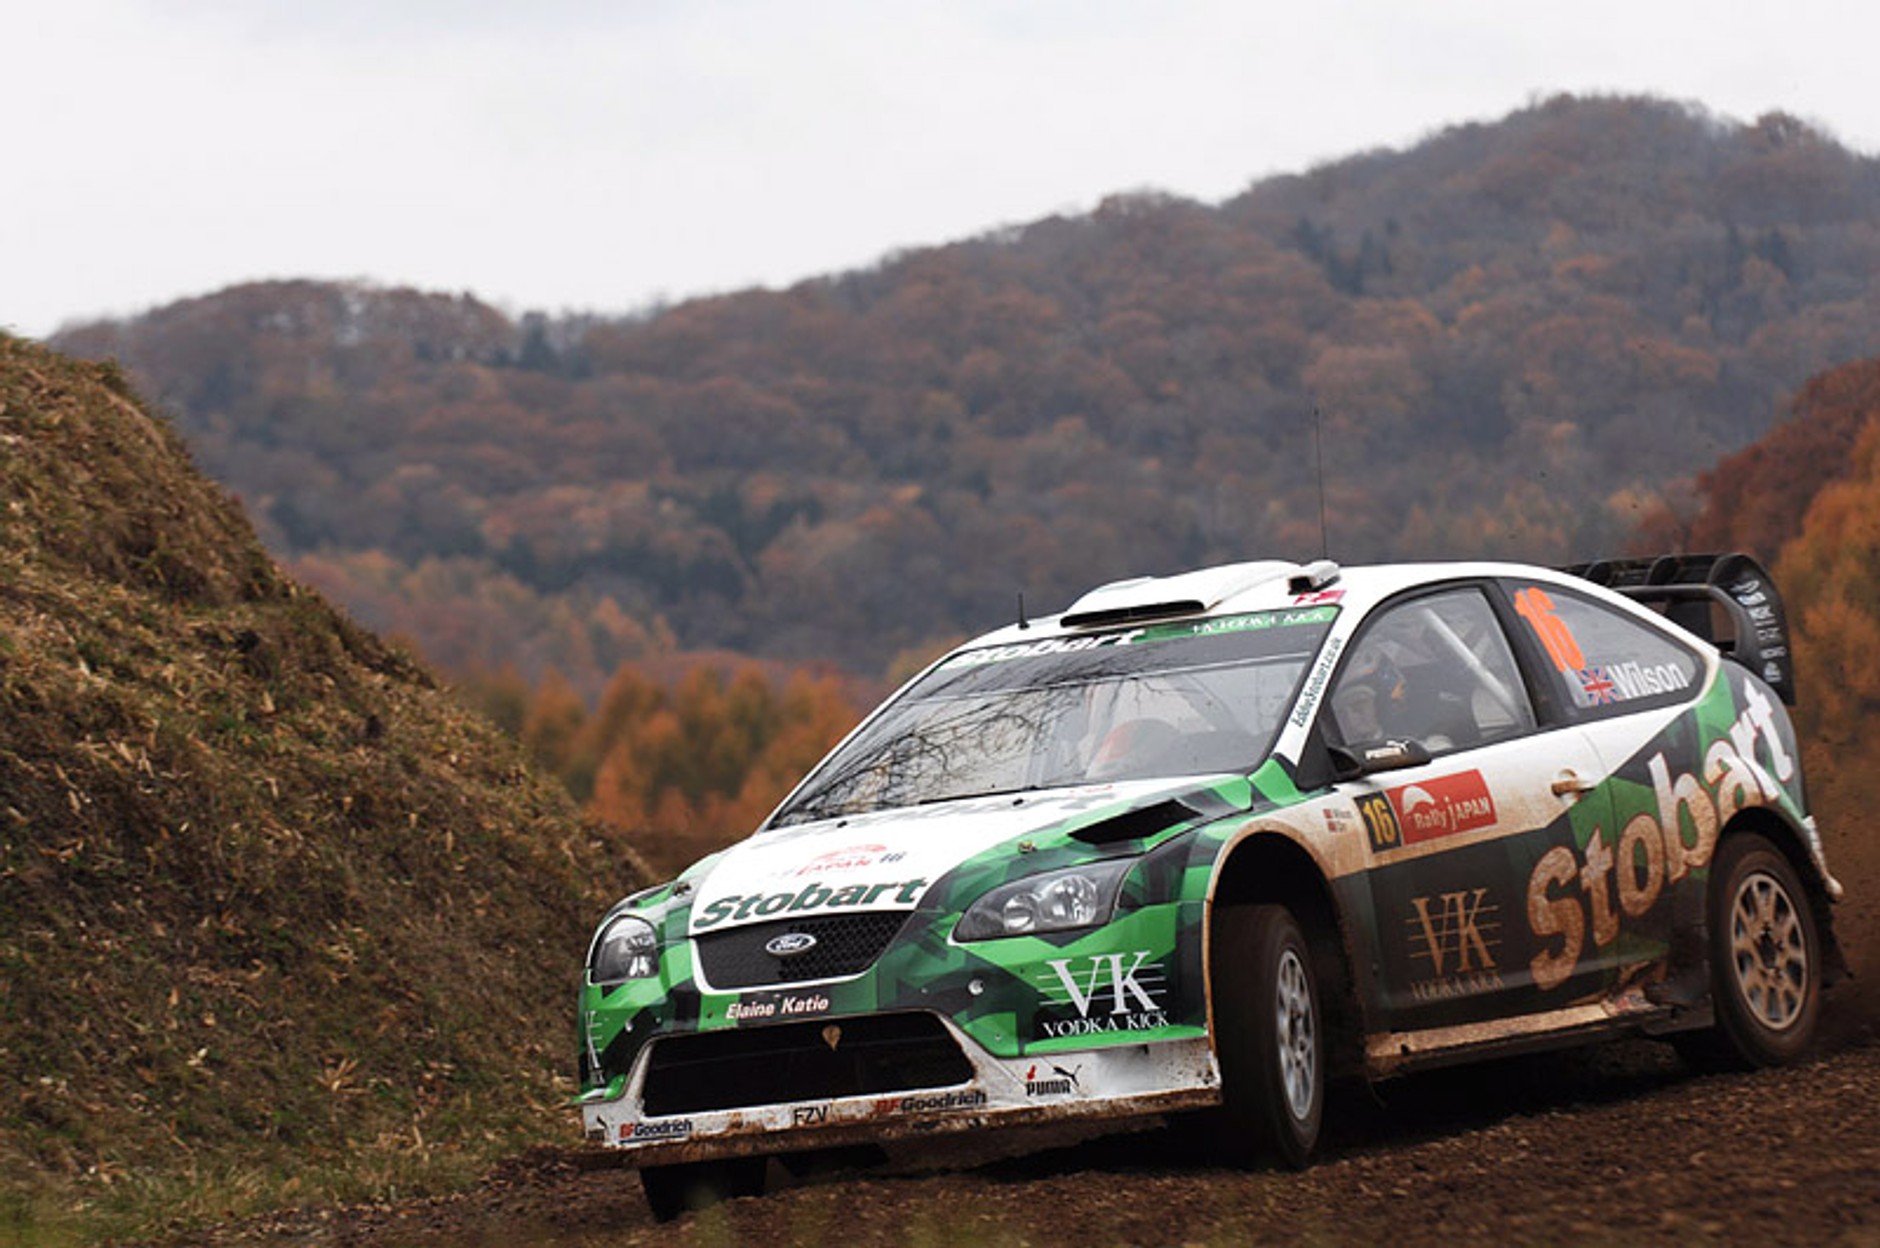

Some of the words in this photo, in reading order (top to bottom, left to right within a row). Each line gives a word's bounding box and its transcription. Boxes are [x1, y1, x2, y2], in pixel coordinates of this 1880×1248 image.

[1514, 586, 1586, 673] 16
[1607, 660, 1689, 700] Wilson
[1363, 798, 1397, 846] 16
[1414, 809, 1447, 830] Rally
[1527, 677, 1795, 991] Stobart
[693, 877, 929, 928] Stobart
[1412, 888, 1488, 975] VK
[1045, 950, 1151, 1018] VK
[726, 1001, 775, 1020] Elaine
[1042, 1018, 1119, 1038] VODKA
[1126, 1010, 1170, 1031] KICK
